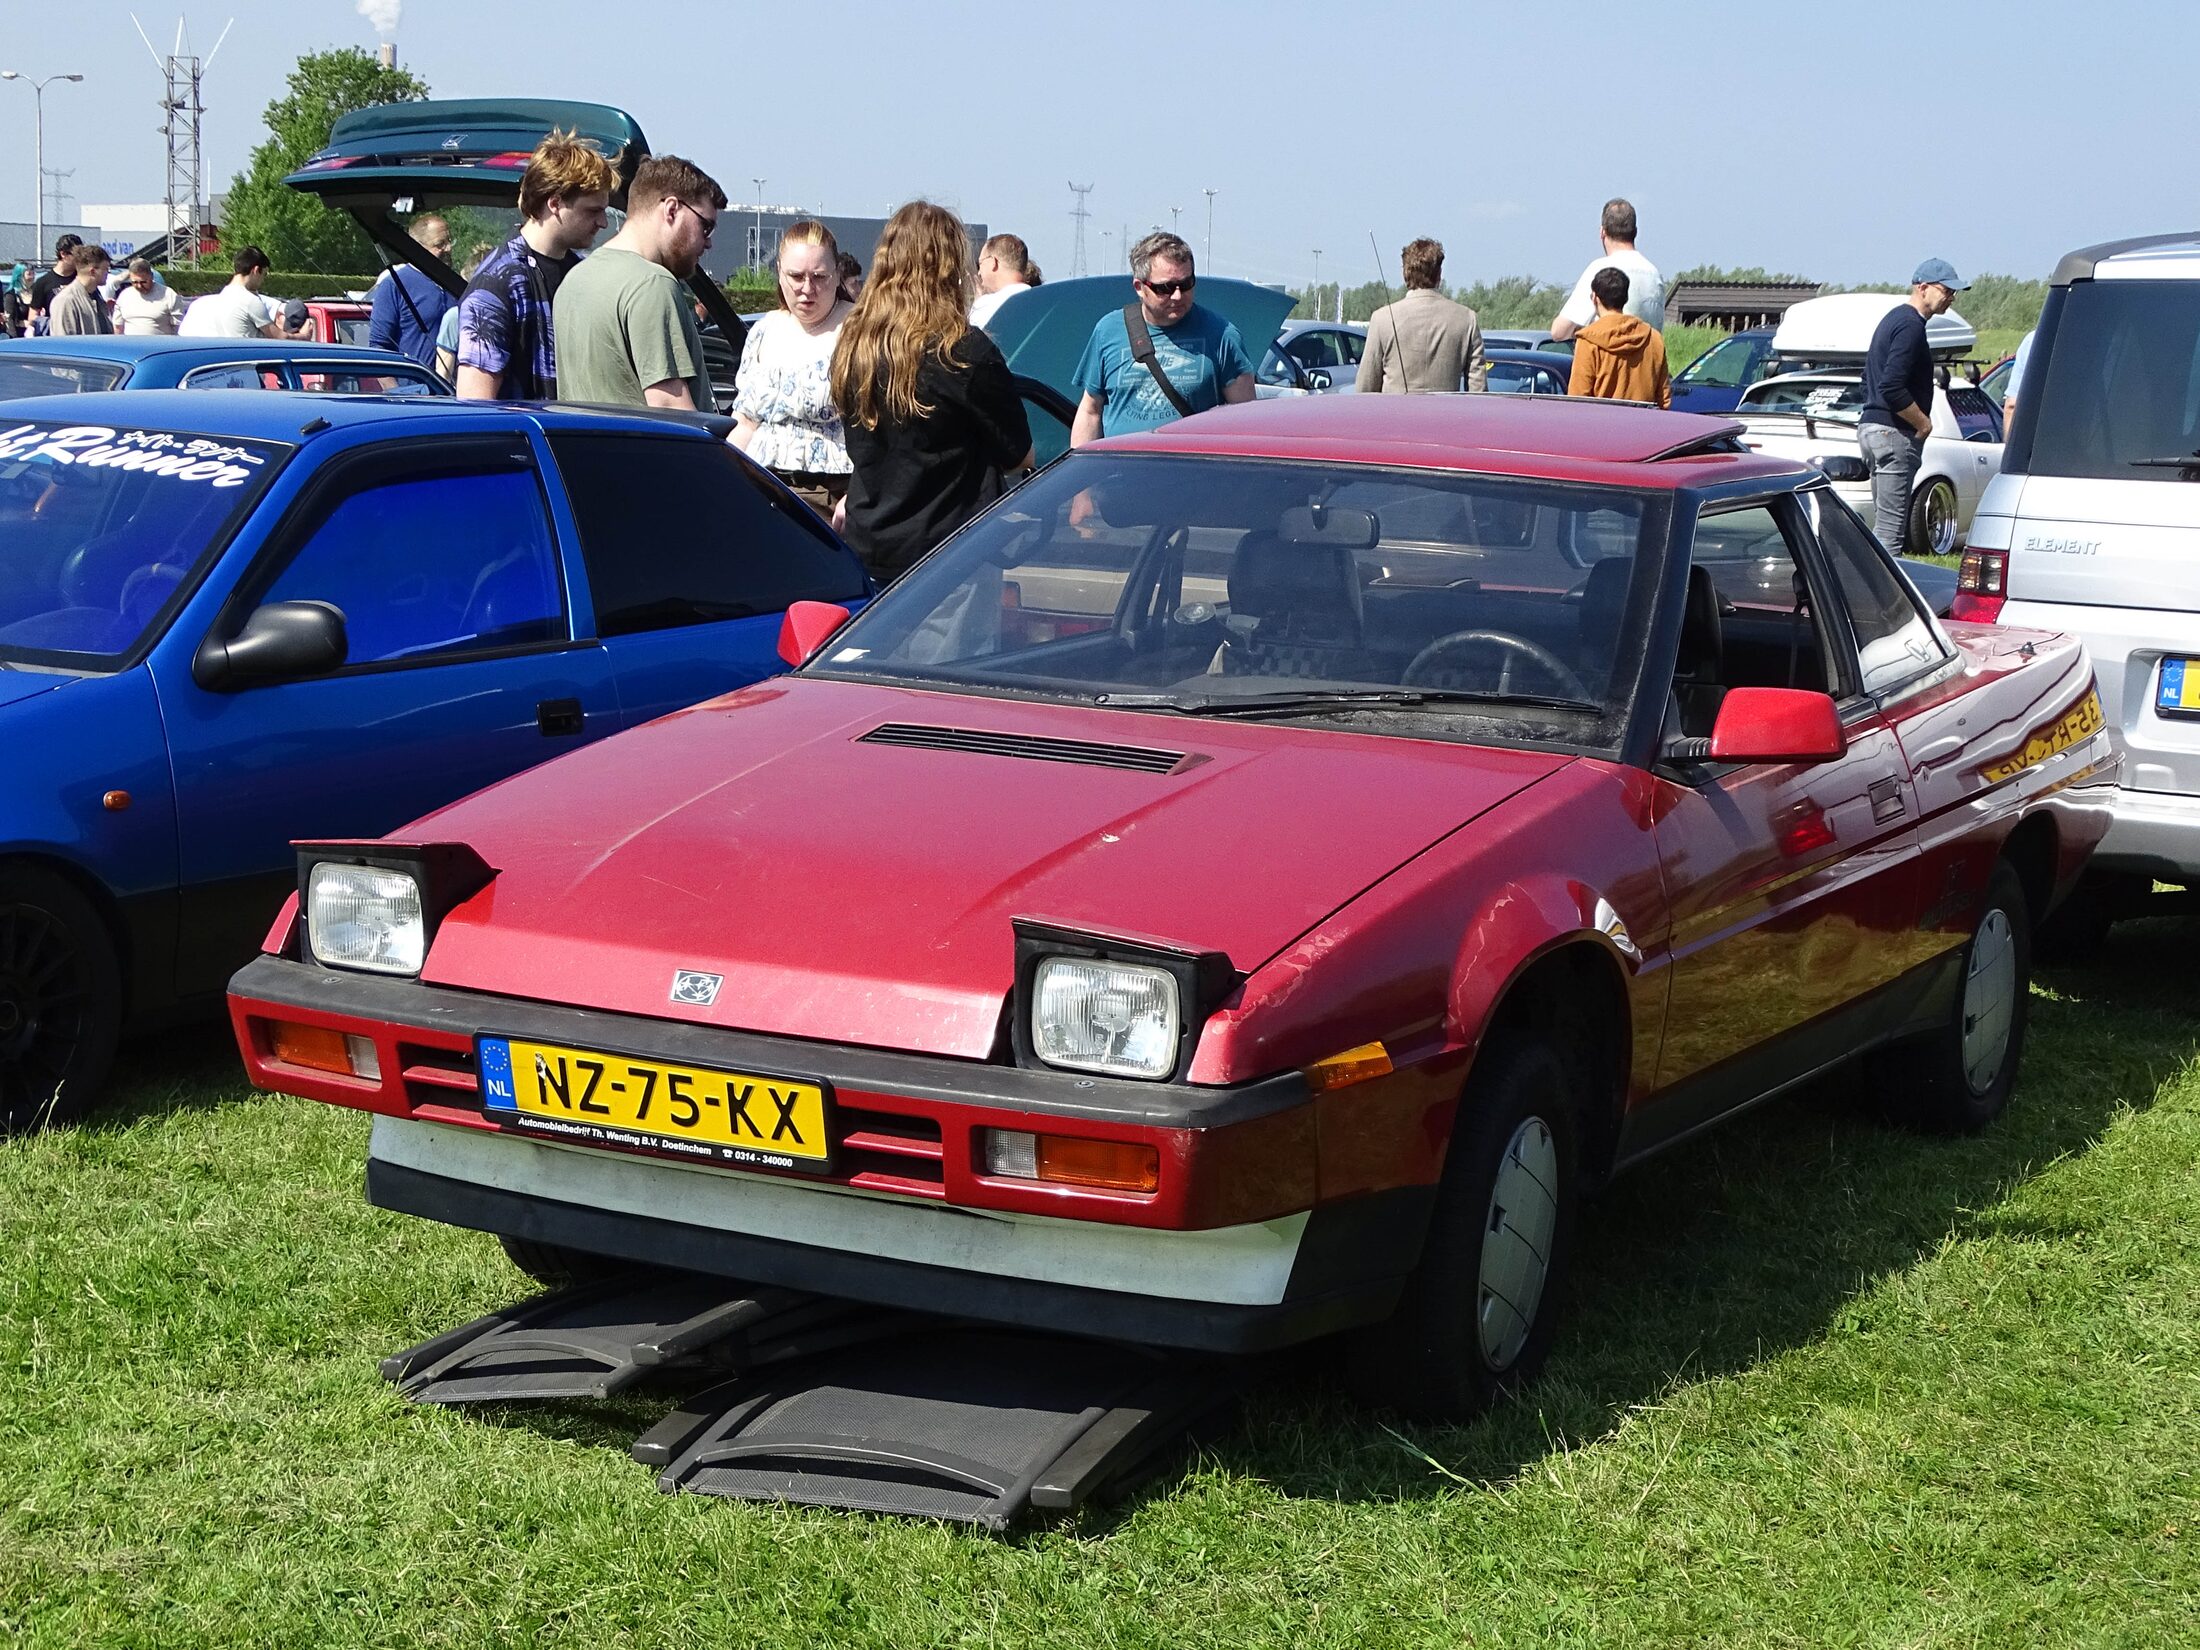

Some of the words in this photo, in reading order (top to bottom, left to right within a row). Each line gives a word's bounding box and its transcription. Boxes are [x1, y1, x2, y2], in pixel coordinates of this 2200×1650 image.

[1152, 409, 1177, 421] LEGE
[19, 426, 250, 488] Runner
[2024, 537, 2102, 556] ELEMENT
[2163, 687, 2179, 699] NL
[487, 1078, 512, 1098] NL
[535, 1053, 805, 1144] NZ-75-KX
[517, 1116, 591, 1137] Automobielbedrijf
[591, 1128, 605, 1139] Th.
[606, 1130, 640, 1146] Wenting
[641, 1137, 658, 1148] B.V.
[661, 1139, 712, 1156] Doetinchem
[734, 1150, 756, 1162] 0314
[762, 1154, 793, 1168] 340000
